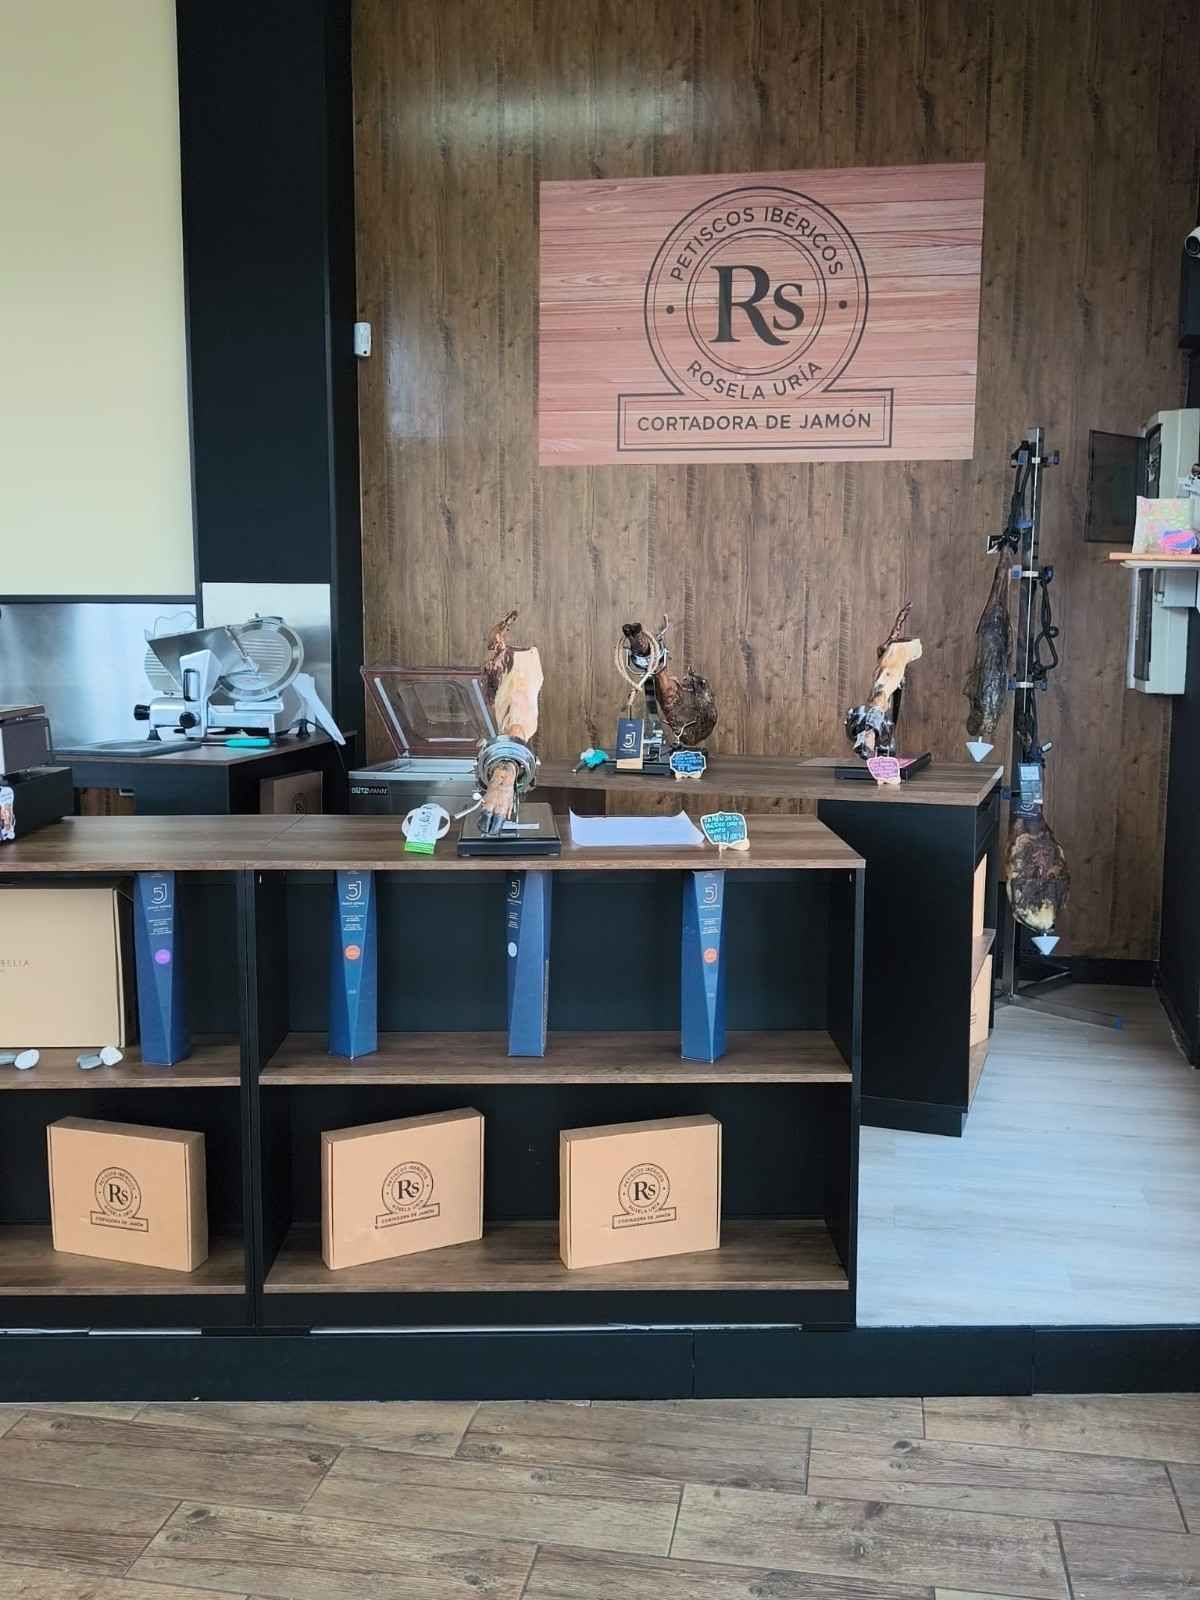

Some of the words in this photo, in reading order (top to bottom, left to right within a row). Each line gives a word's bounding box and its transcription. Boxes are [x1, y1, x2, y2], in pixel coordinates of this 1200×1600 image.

[670, 207, 754, 281] PETISCOS
[764, 206, 844, 275] IBÉRICOS
[708, 265, 805, 346] Rs
[686, 360, 766, 400] ROSELA
[773, 362, 822, 396] URÍA
[637, 415, 758, 432] CORTADORA
[766, 415, 791, 430] DE
[799, 409, 871, 429] JAMÓN
